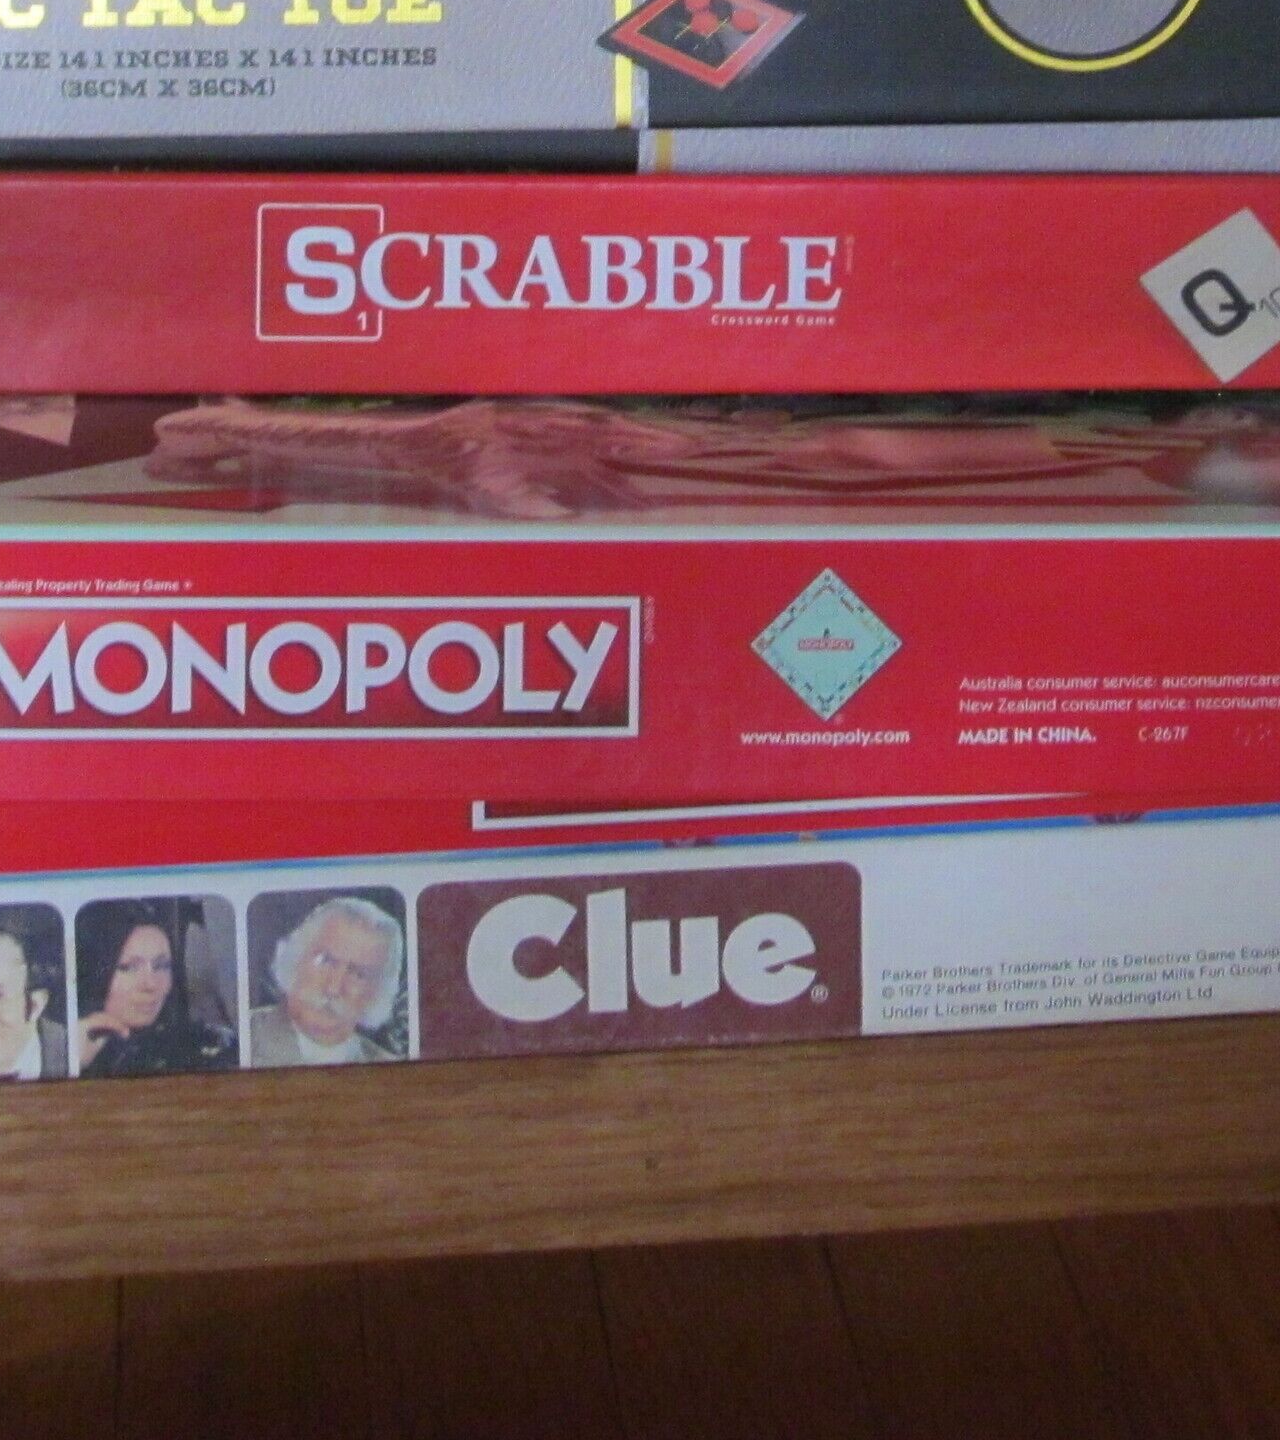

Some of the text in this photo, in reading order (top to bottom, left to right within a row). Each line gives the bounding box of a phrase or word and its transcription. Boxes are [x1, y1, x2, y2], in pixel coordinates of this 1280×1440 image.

[113, 48, 230, 68] INCHES
[237, 48, 260, 68] X
[322, 46, 439, 67] INCHES
[158, 78, 179, 98] X
[285, 225, 843, 316] SCRABBLE
[1181, 268, 1257, 337] Q
[710, 313, 836, 326] Crossword Game
[36, 579, 92, 594] Property
[95, 579, 140, 594] Trading
[143, 580, 179, 592] Game
[960, 675, 1022, 691] Australia
[1027, 677, 1098, 691] consumer
[959, 698, 994, 713] New
[998, 697, 1057, 713] Zealand
[1061, 698, 1133, 712] consumer
[741, 728, 910, 747] www.monopoly.com
[958, 728, 1008, 745] MADE
[1014, 727, 1033, 744] IN
[1038, 727, 1097, 744] CHINA.
[467, 888, 817, 1022] Clue
[882, 967, 928, 981] Parker
[933, 965, 993, 979] Brothers
[1000, 958, 1071, 975] Trademark
[1078, 957, 1097, 970] for
[1123, 950, 1191, 967] Detective
[1196, 948, 1237, 962] Game
[900, 983, 932, 998] 1972
[936, 981, 982, 996] Parker
[986, 978, 1047, 993] Brothers
[1084, 974, 1098, 986] of
[1103, 969, 1157, 985] General
[1162, 967, 1195, 981] Mills
[1200, 965, 1225, 978] Fun
[1229, 964, 1272, 979] Group
[882, 1005, 928, 1020] Under
[934, 1002, 997, 1017] License
[1004, 998, 1039, 1012] from
[1044, 995, 1082, 1010] John
[1088, 989, 1182, 1007] Waddington
